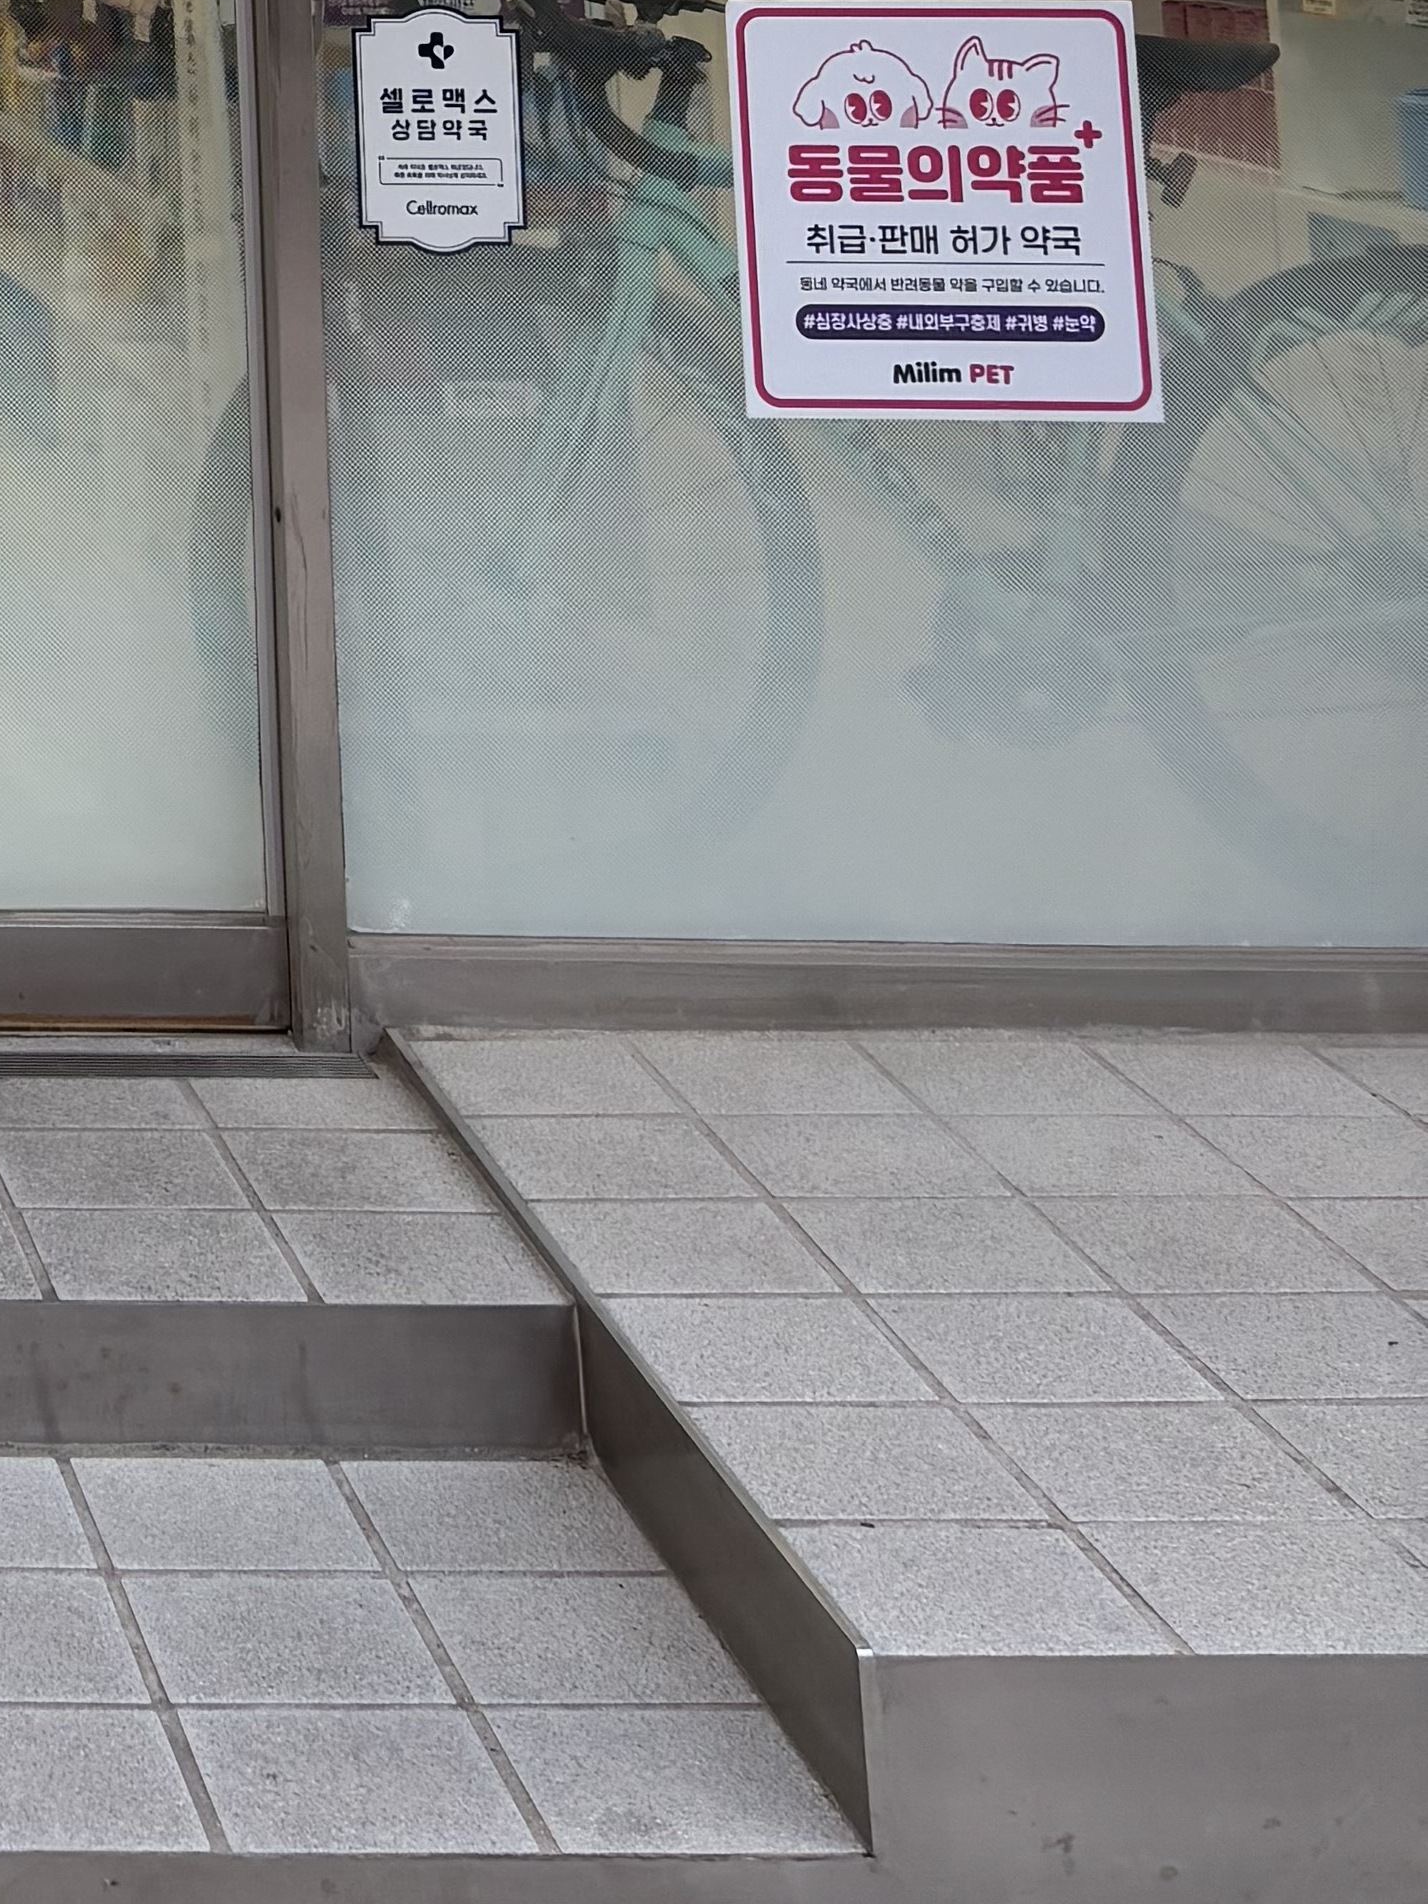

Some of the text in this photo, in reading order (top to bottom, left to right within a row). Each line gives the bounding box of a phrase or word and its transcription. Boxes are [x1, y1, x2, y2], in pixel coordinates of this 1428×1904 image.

[379, 87, 499, 115] 셀로맥스
[390, 118, 489, 142] 상담약국
[786, 144, 1085, 205] 동물의약품
[405, 199, 479, 216] Cellromax
[950, 224, 1012, 256] 허가
[1020, 225, 1083, 257] 약국
[799, 276, 828, 292] 동네
[831, 276, 887, 292] 약국에서
[890, 276, 947, 293] 반려동물
[949, 277, 978, 293] 약을
[981, 277, 1023, 294] 구입할
[1027, 278, 1041, 293] 수
[892, 362, 1015, 385] Milim PET
